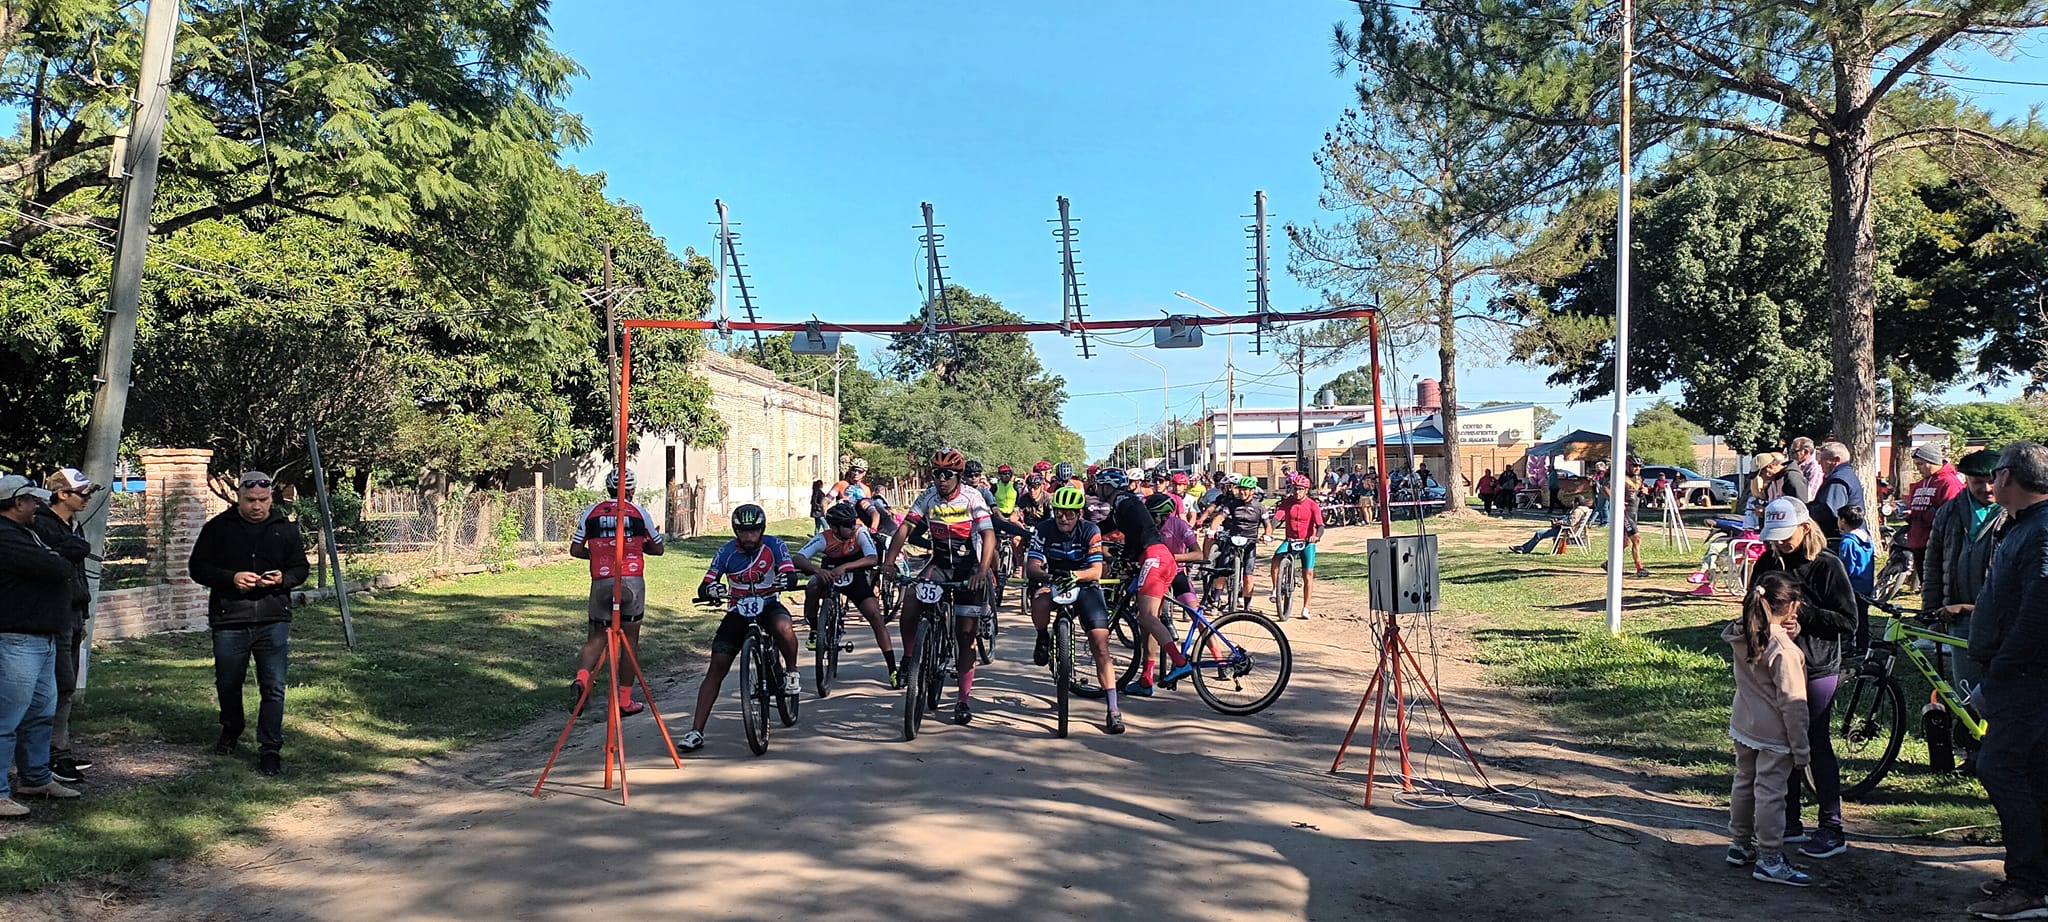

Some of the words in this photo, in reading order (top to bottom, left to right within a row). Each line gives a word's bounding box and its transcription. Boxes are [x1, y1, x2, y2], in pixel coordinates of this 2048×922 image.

[600, 516, 630, 528] CUA
[921, 585, 936, 600] 35
[744, 601, 758, 615] 18
